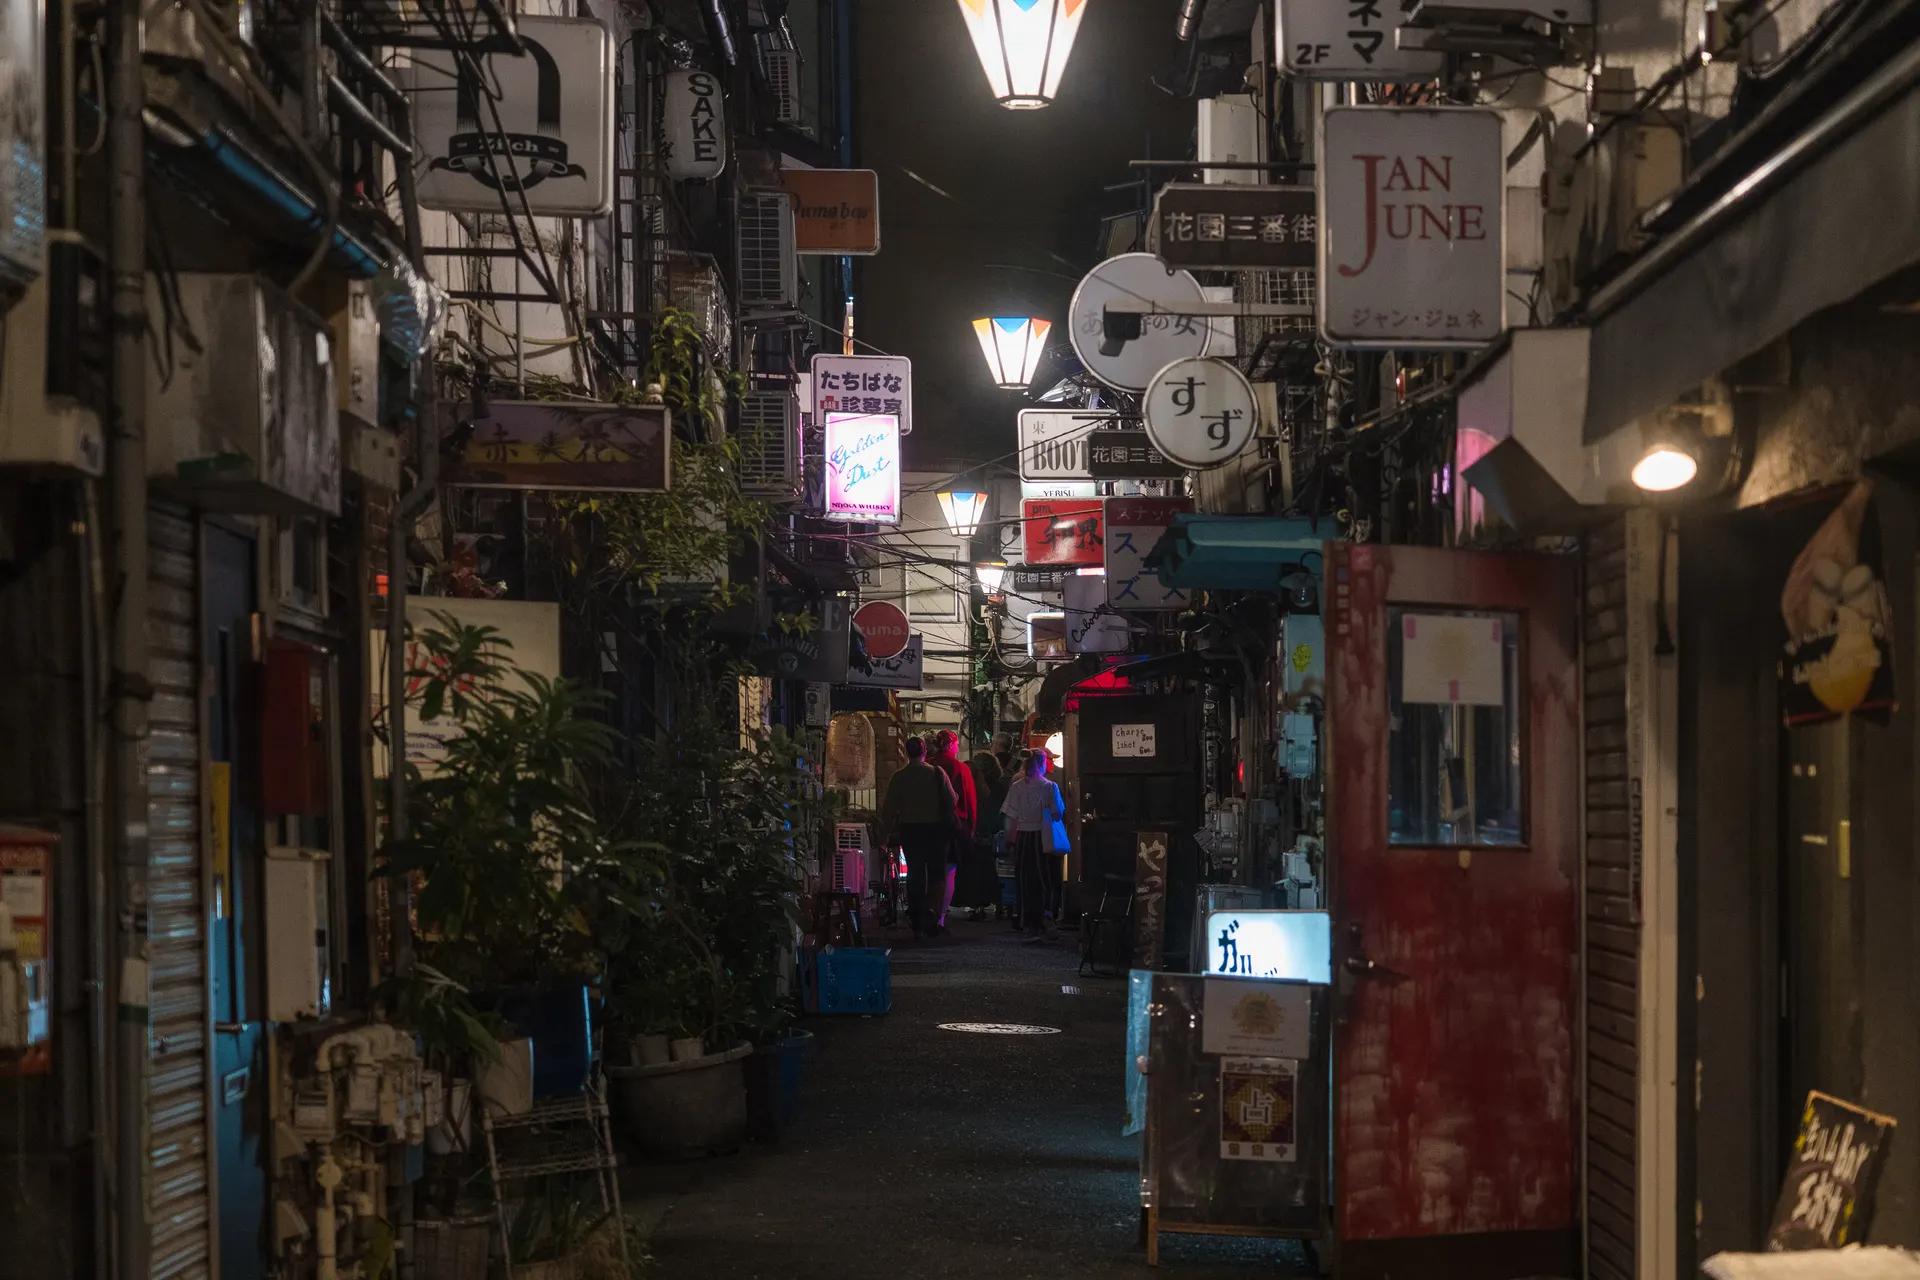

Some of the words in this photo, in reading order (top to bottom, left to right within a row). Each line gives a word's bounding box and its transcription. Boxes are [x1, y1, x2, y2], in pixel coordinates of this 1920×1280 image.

[1296, 44, 1330, 65] 2F
[688, 73, 717, 162] SAKE
[1164, 211, 1317, 244] 花園三番街
[1352, 308, 1485, 330] ジャン・ジュネ
[820, 371, 903, 394] たちばな
[1164, 376, 1243, 451] すず
[844, 456, 891, 493] Dust
